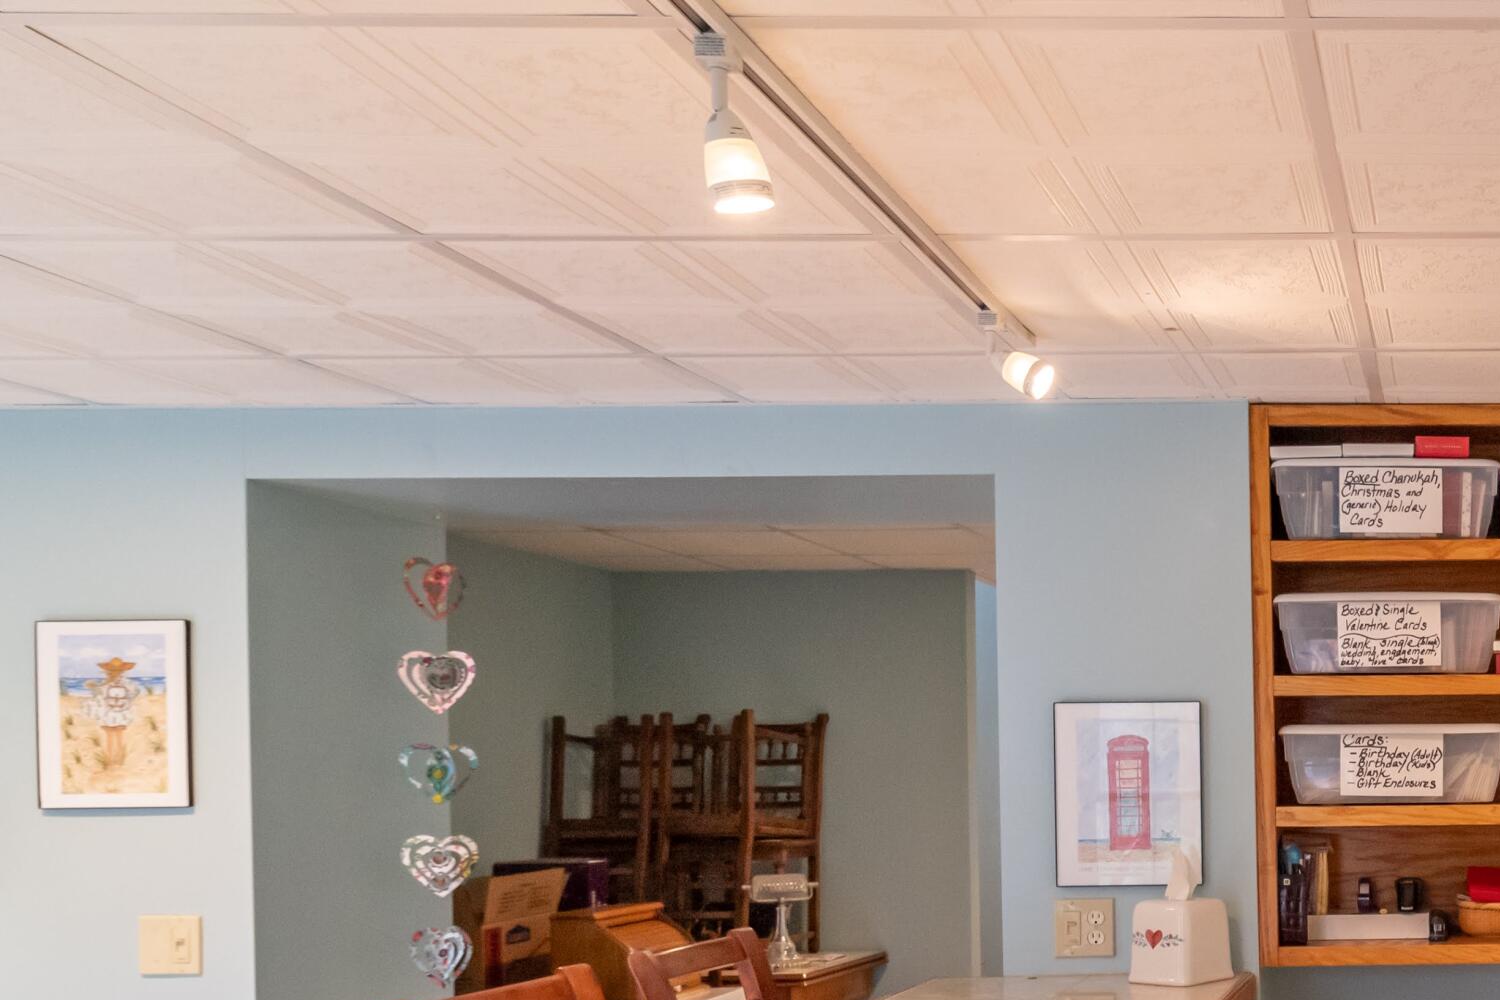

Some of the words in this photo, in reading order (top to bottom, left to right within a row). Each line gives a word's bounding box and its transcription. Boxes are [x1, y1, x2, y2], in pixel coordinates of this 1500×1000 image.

[1344, 470, 1380, 485] Boxed
[1341, 485, 1401, 498] Christmas
[1405, 487, 1423, 497] and
[1341, 499, 1381, 515] (generic)
[1384, 500, 1427, 519] Holiday
[1350, 513, 1384, 527] Cards
[1341, 603, 1374, 616] Boxed
[1382, 603, 1419, 618] Single
[1346, 618, 1390, 631] Valentine
[1394, 617, 1427, 631] Cards
[1343, 734, 1389, 747] Cards:
[1359, 746, 1410, 761] Birthday
[1358, 757, 1406, 772] Birthday
[1356, 768, 1390, 778] Blank
[1357, 777, 1382, 789] Gift
[1383, 776, 1437, 789] Enclosures
